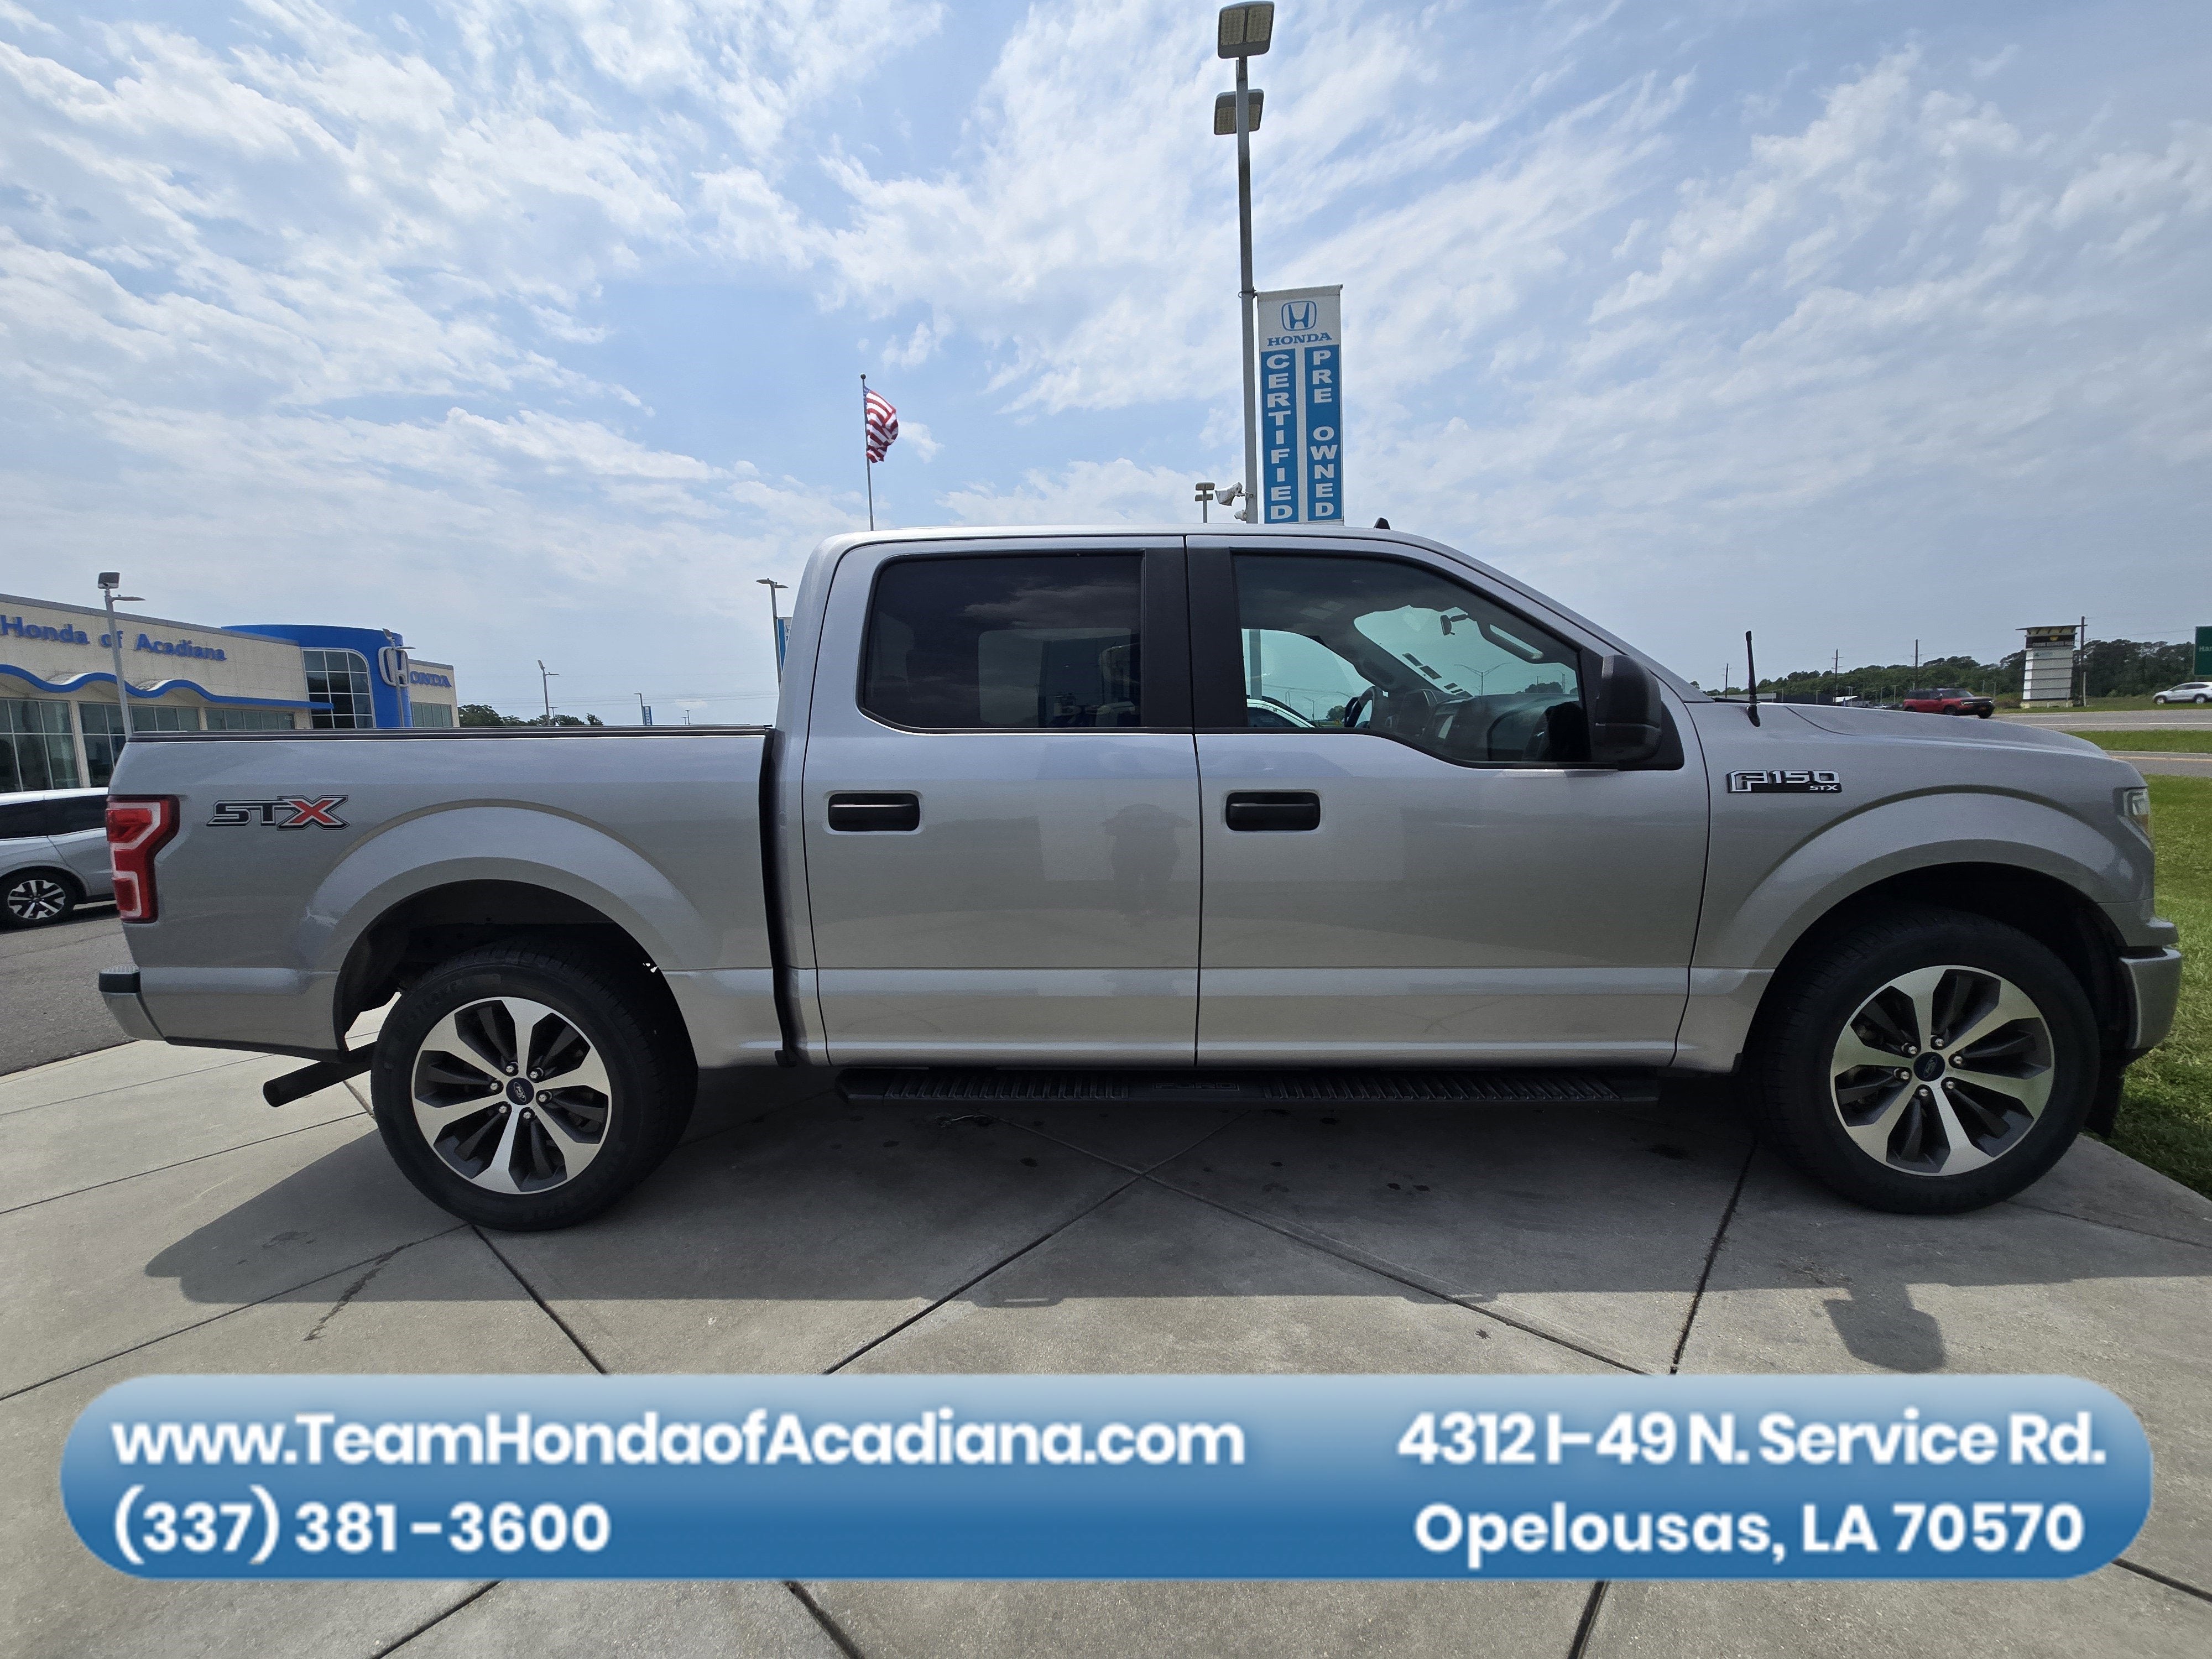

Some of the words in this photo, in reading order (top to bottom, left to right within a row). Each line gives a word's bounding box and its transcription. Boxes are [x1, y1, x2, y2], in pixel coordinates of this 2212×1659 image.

[1267, 332, 1332, 346] HONDA
[1312, 350, 1332, 403] PRE
[1266, 353, 1293, 520] CERTIFIED
[1310, 426, 1338, 517] OWNED
[0, 614, 90, 645] Honda
[99, 630, 124, 649] of
[133, 633, 227, 661] Acadiana
[410, 671, 452, 687] ONDA
[206, 795, 351, 830] STX
